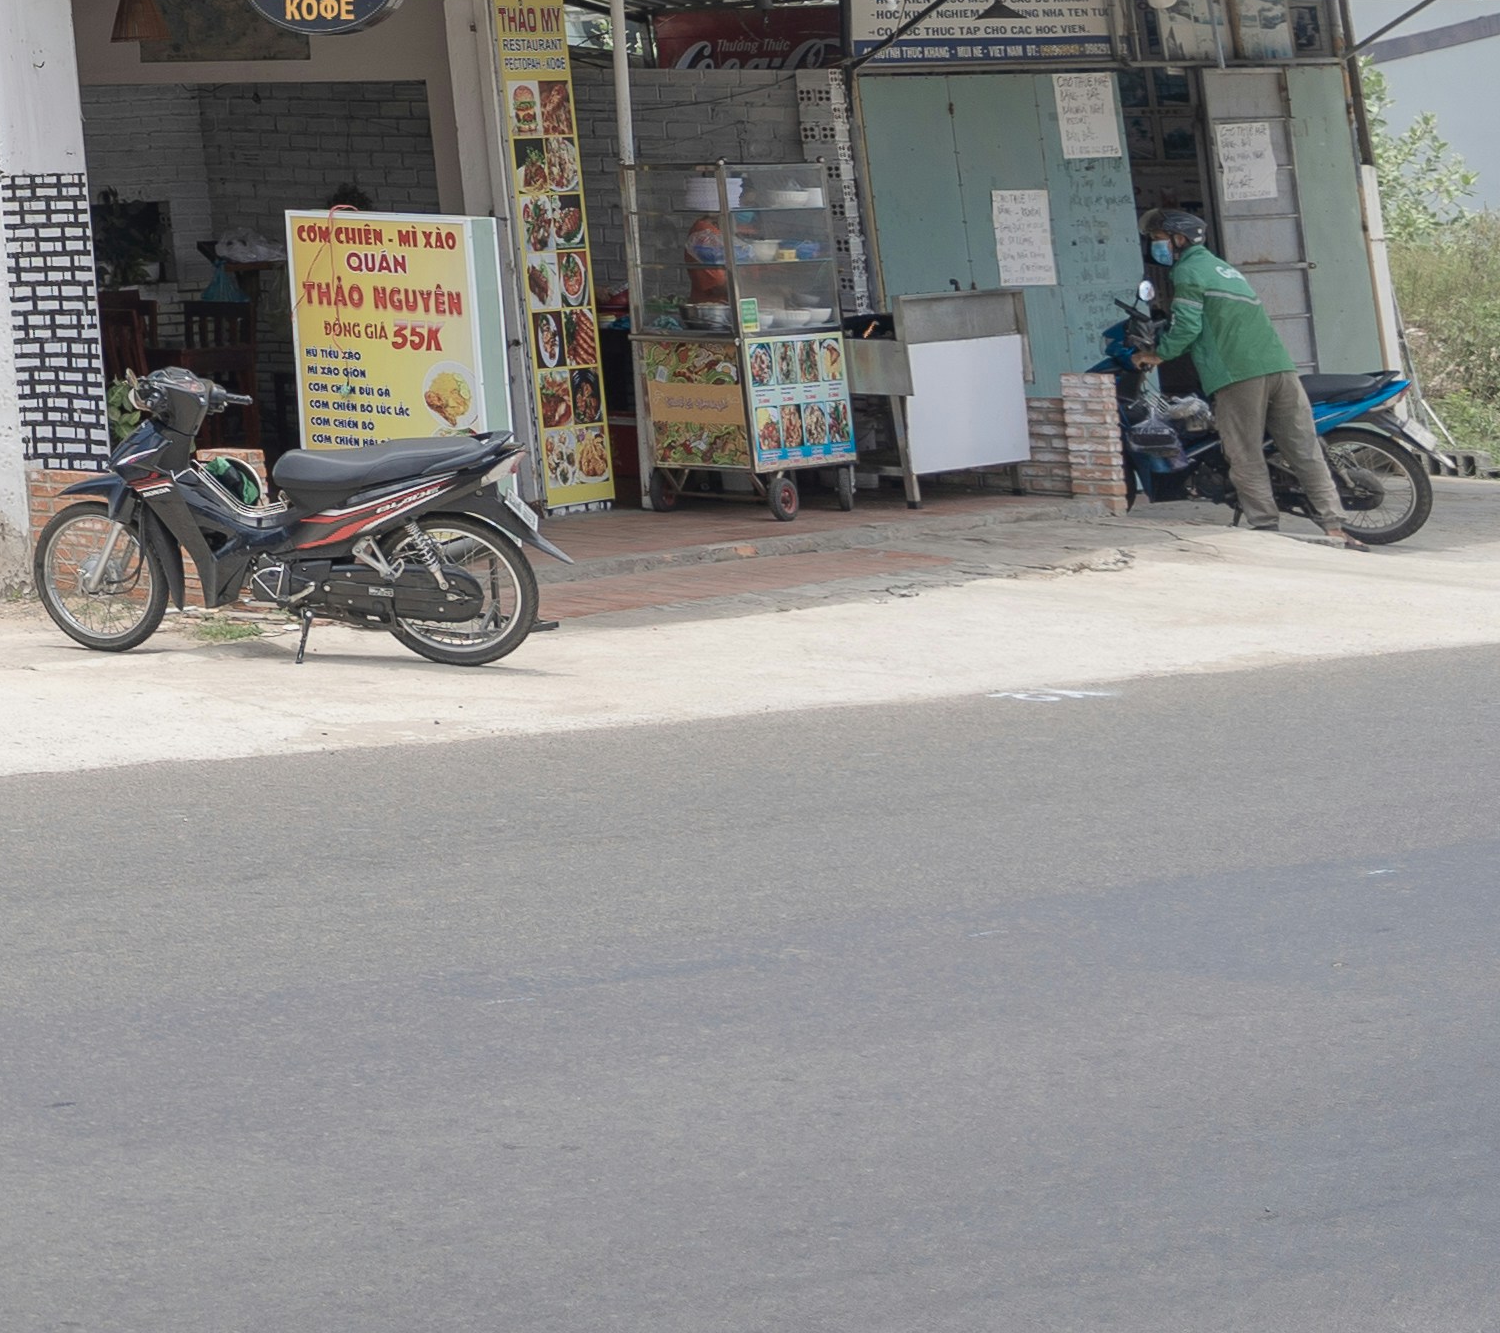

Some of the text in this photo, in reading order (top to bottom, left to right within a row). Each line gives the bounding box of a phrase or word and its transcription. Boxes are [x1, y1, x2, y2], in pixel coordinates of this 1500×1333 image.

[540, 8, 561, 32] MY
[984, 26, 1007, 35] CHO
[1011, 25, 1032, 35] CAC
[502, 38, 563, 52] RESTAURANT
[297, 222, 331, 244] CƠM
[335, 224, 383, 247] CHIÊN
[397, 225, 419, 248] MÌ
[422, 227, 457, 251] XÀO
[346, 250, 408, 274] QUÁN
[302, 276, 463, 317] THẢO NGUYÊN
[365, 321, 389, 340] GIÁ
[391, 318, 446, 352] 35K
